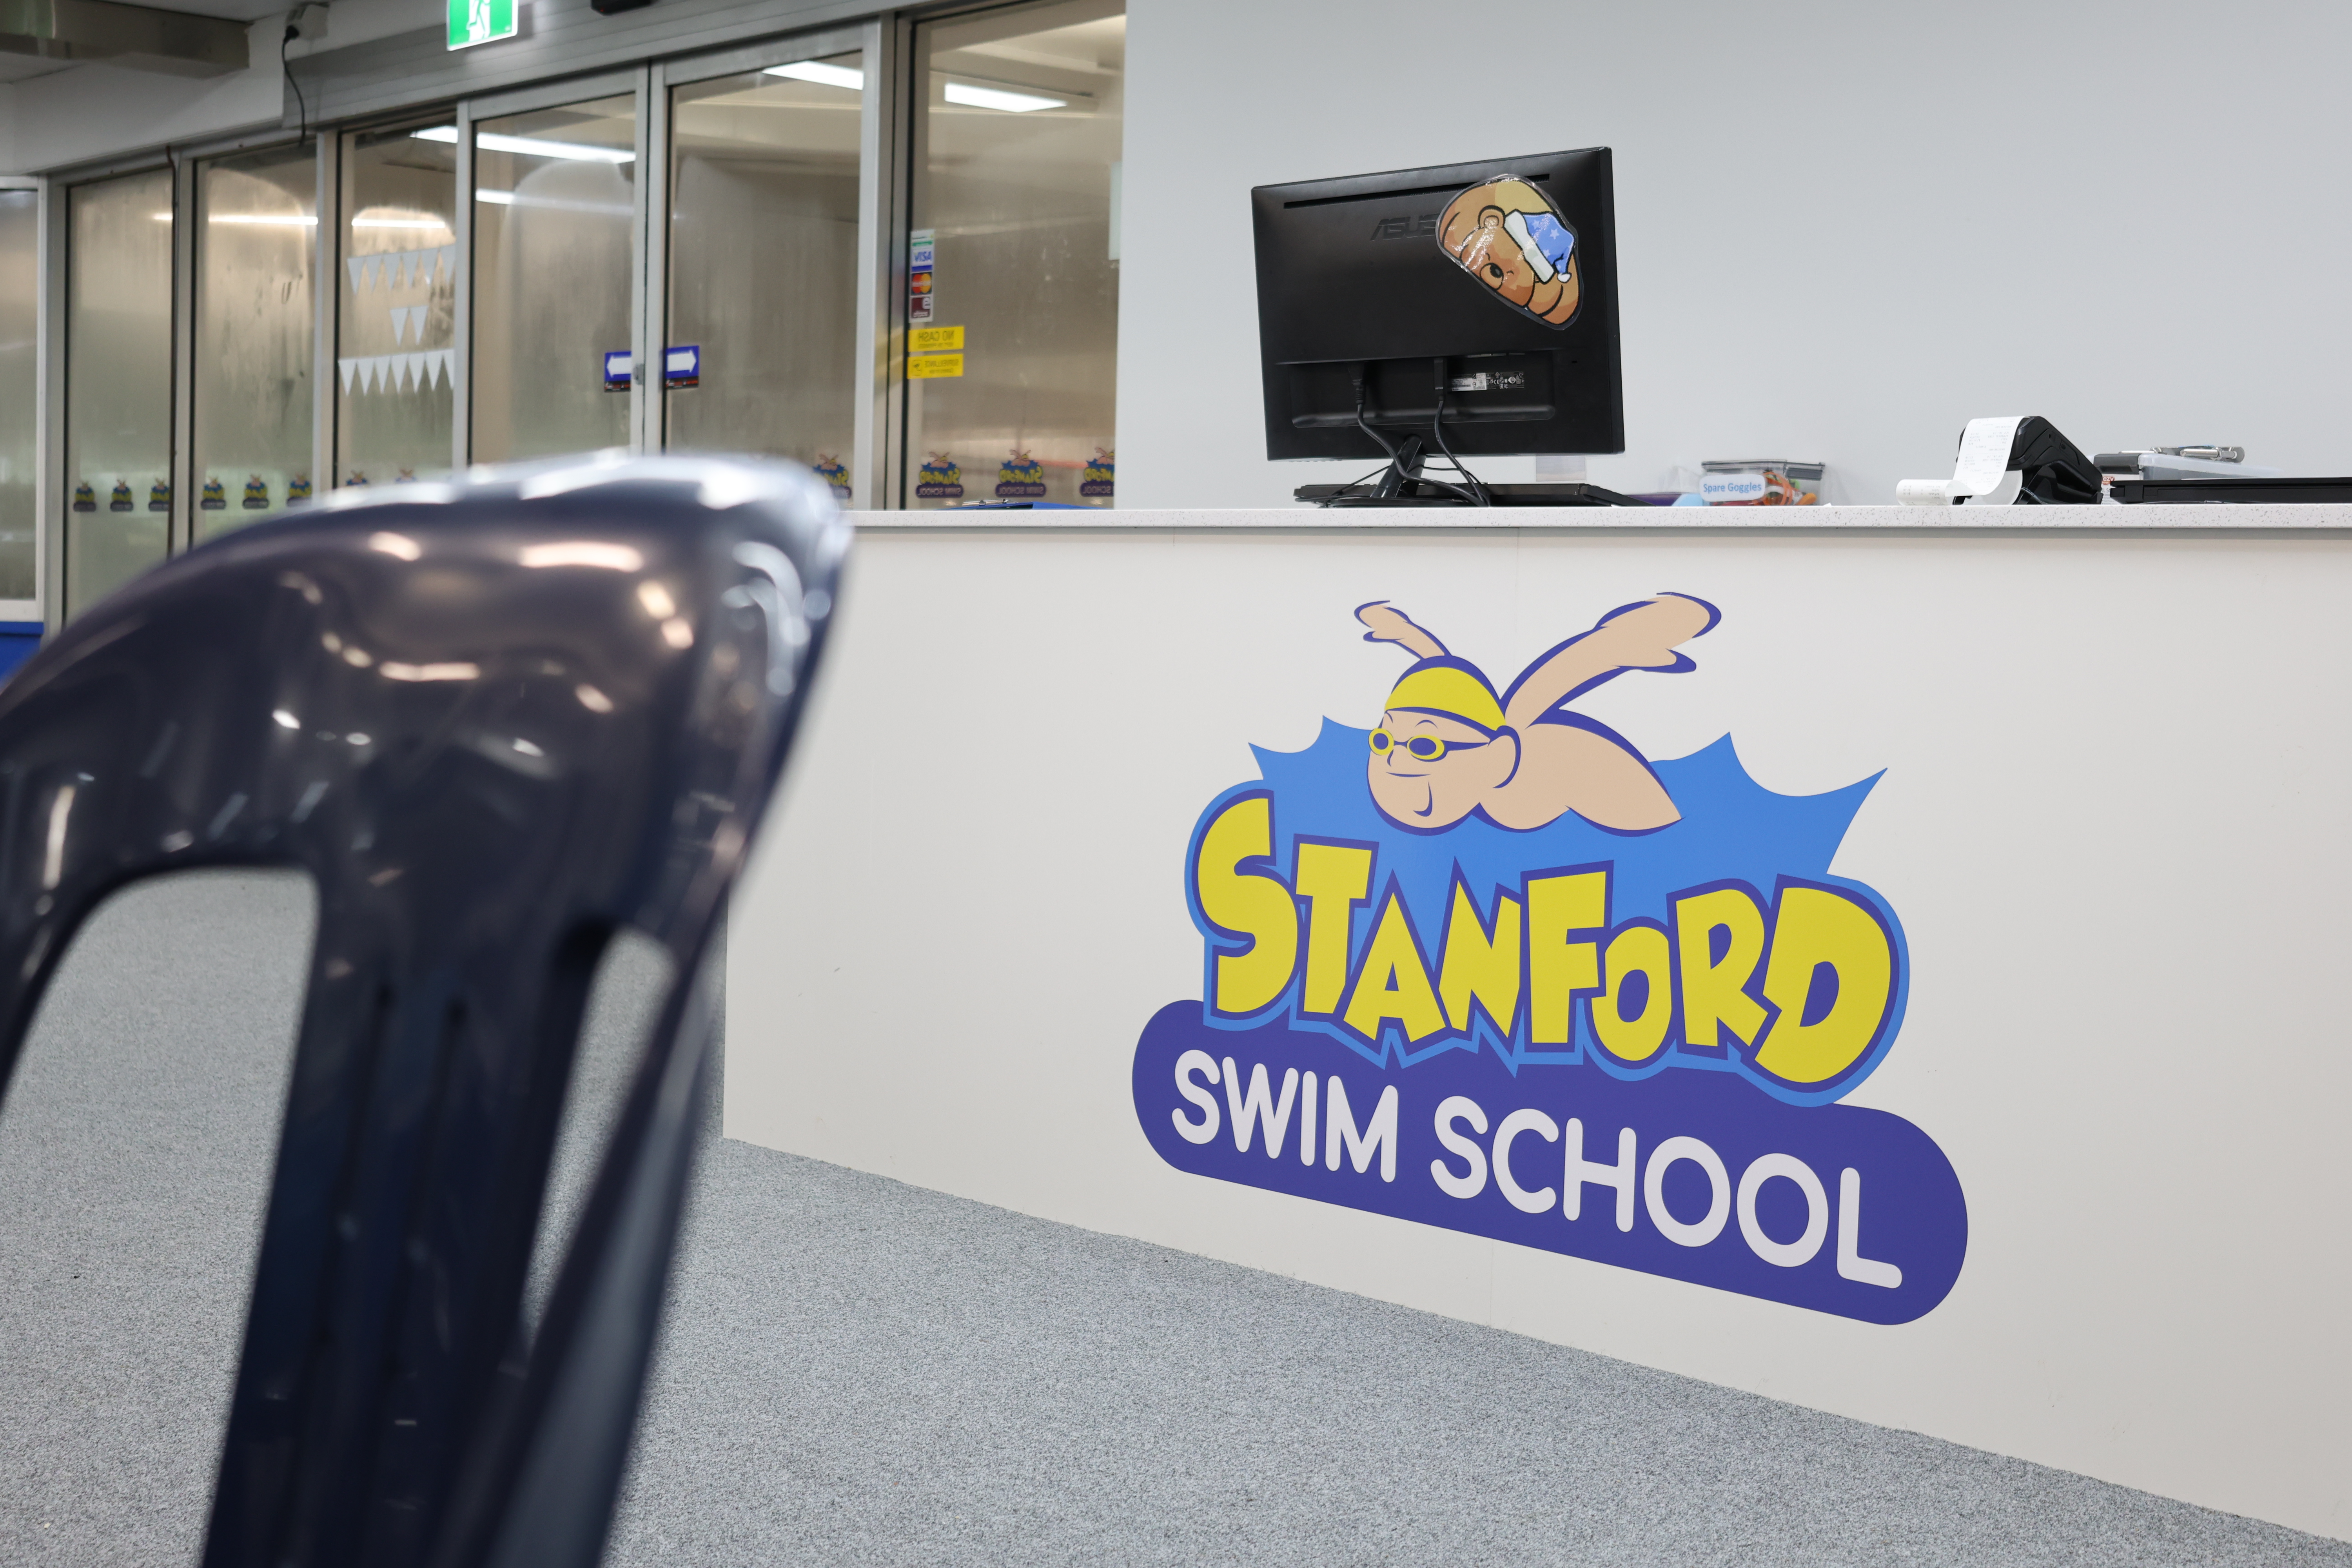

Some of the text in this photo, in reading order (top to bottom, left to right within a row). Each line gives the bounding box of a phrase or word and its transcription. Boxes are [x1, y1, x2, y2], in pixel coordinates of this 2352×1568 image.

[914, 251, 932, 263] VISA
[1703, 482, 1762, 494] Spare Goggles
[1197, 797, 1892, 1084] STANFORD
[1171, 1049, 1903, 1289] SWIM SCHOOL
